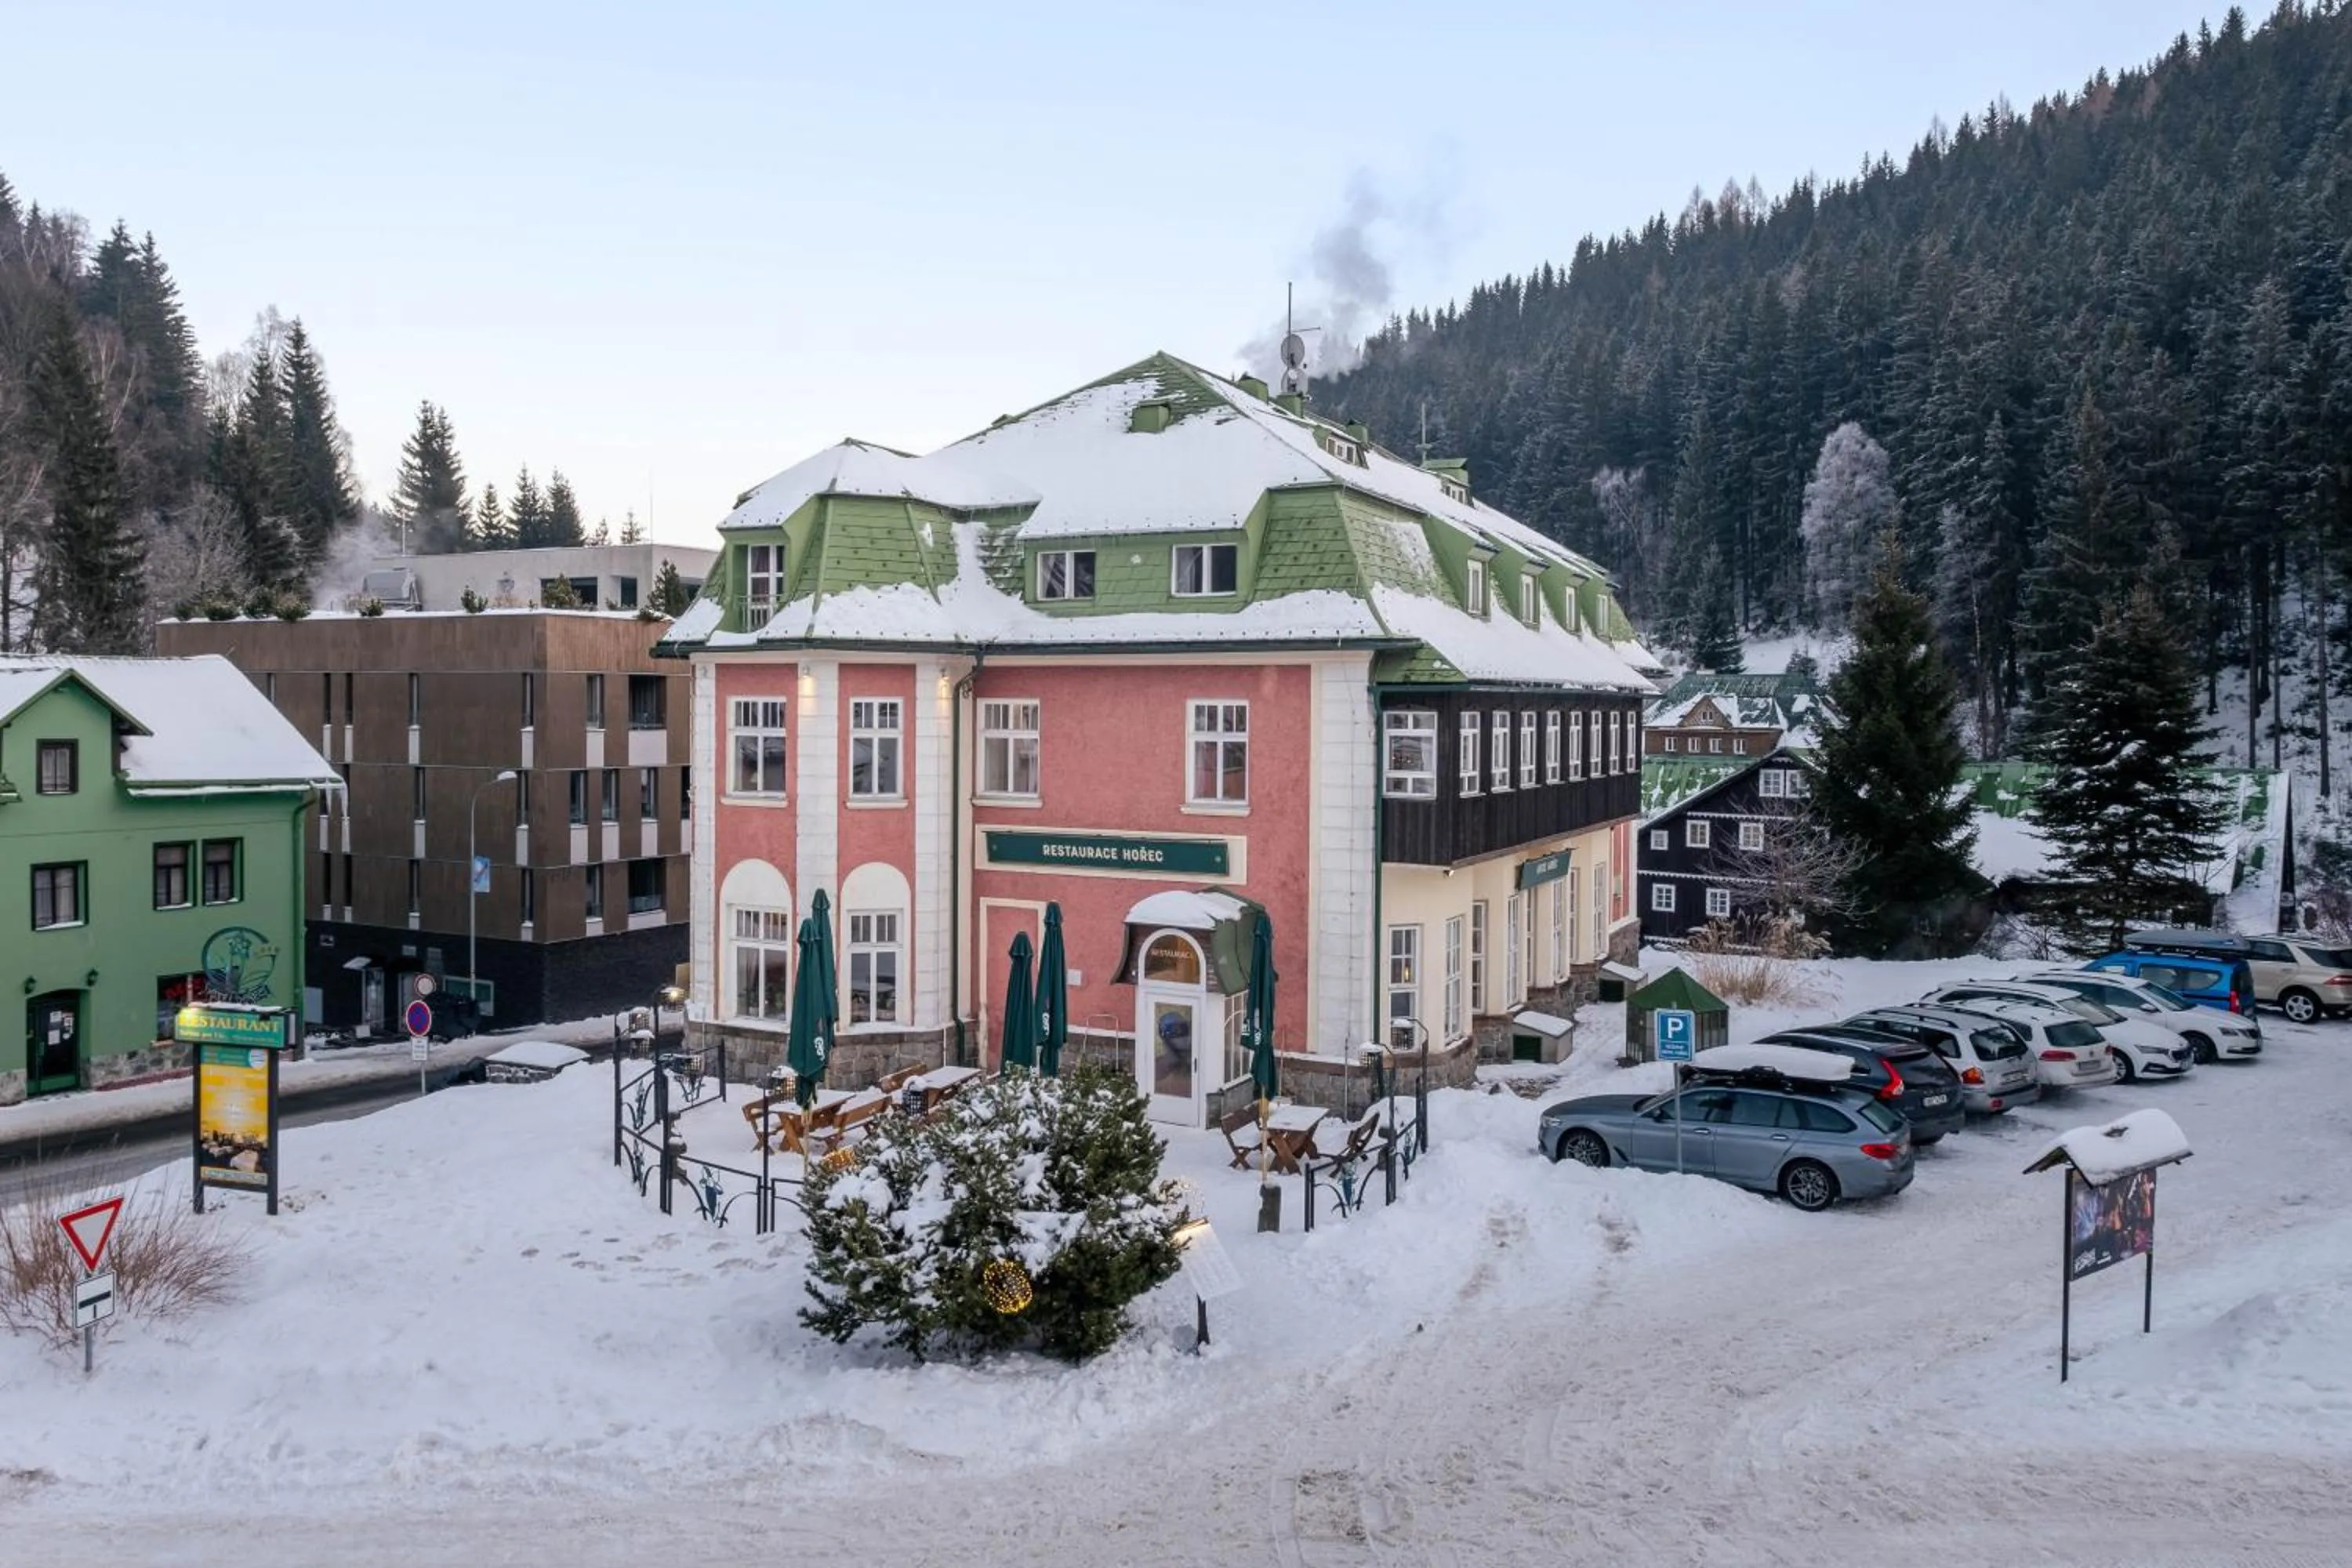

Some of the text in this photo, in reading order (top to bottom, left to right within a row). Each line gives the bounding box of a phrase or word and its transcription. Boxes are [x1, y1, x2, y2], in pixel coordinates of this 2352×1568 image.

[1042, 844, 1164, 862] RESTAURACE HOŘEC
[180, 1014, 278, 1033] ESTAURANT
[1668, 1017, 1683, 1039] P
